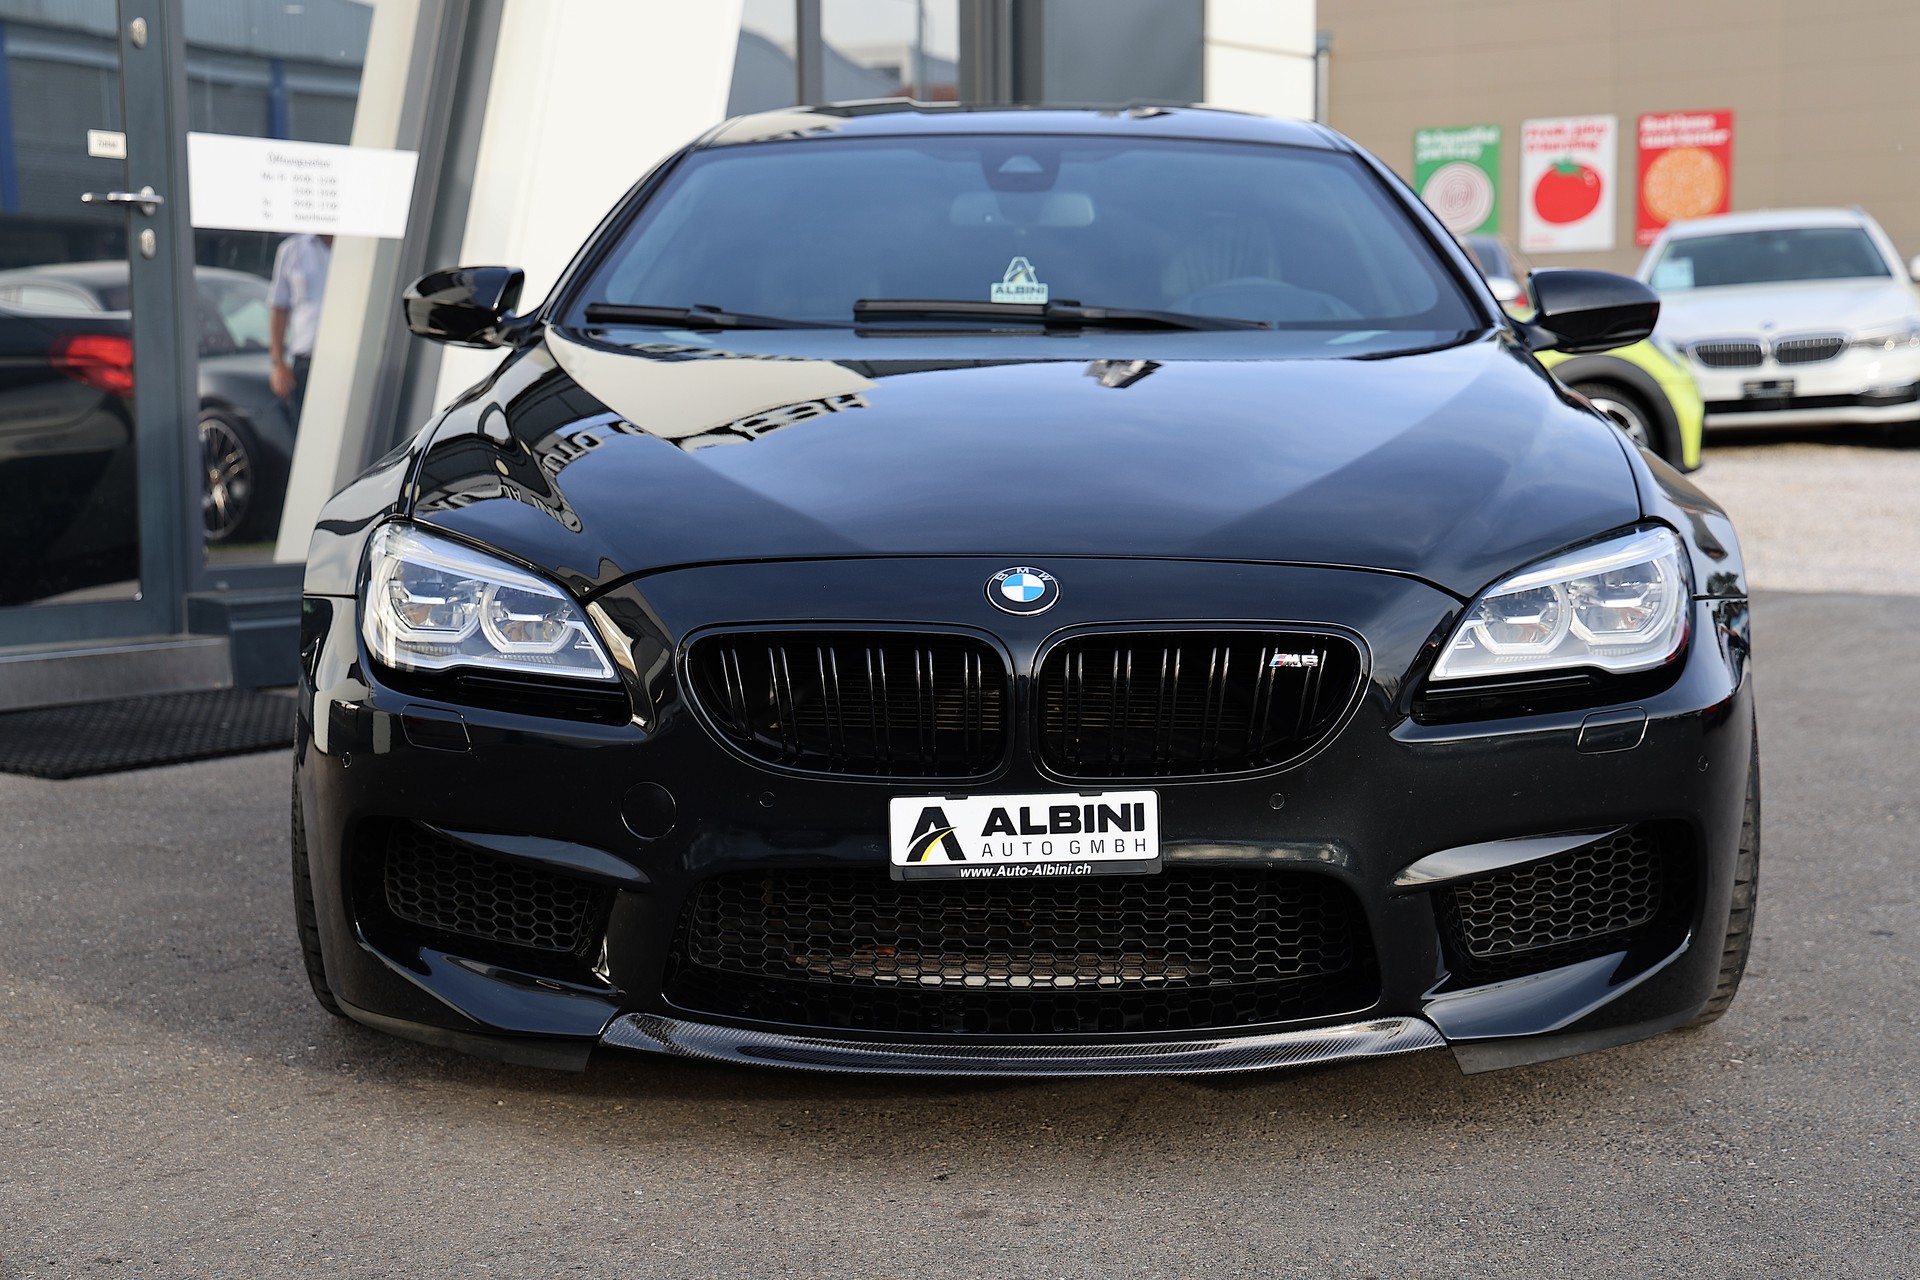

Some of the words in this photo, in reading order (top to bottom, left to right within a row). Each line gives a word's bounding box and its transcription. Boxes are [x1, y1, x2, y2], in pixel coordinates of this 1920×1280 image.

[995, 286, 1045, 294] ALBINI
[994, 567, 1053, 582] BMW
[981, 802, 1145, 837] ALBINI
[981, 840, 1053, 858] AUTO
[1069, 838, 1147, 856] GMBH
[960, 862, 1092, 878] www.Auto-Albini.ch
